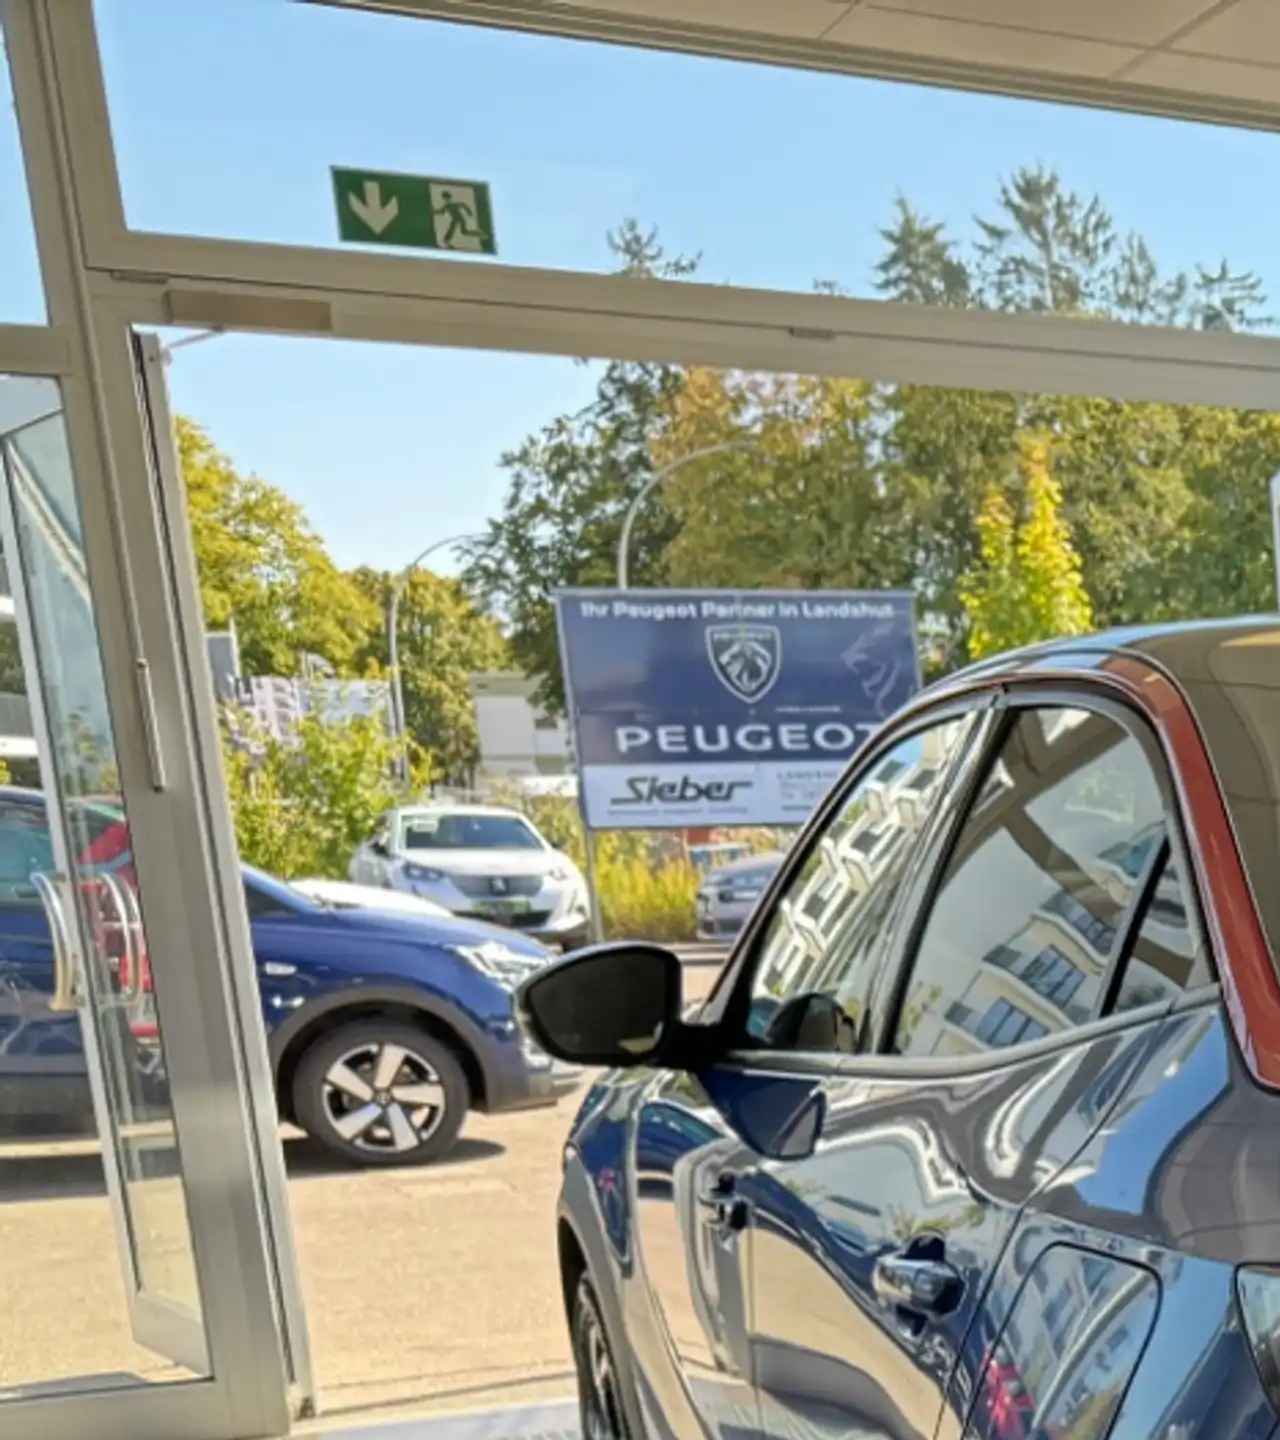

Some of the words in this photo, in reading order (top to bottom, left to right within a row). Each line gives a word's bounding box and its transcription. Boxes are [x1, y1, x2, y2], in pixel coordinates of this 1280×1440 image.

[580, 601, 609, 618] Ihr
[612, 601, 698, 621] Peugeot
[701, 601, 776, 619] Partner
[778, 601, 799, 618] in
[802, 600, 895, 620] Landshut
[609, 774, 753, 806] Sieber
